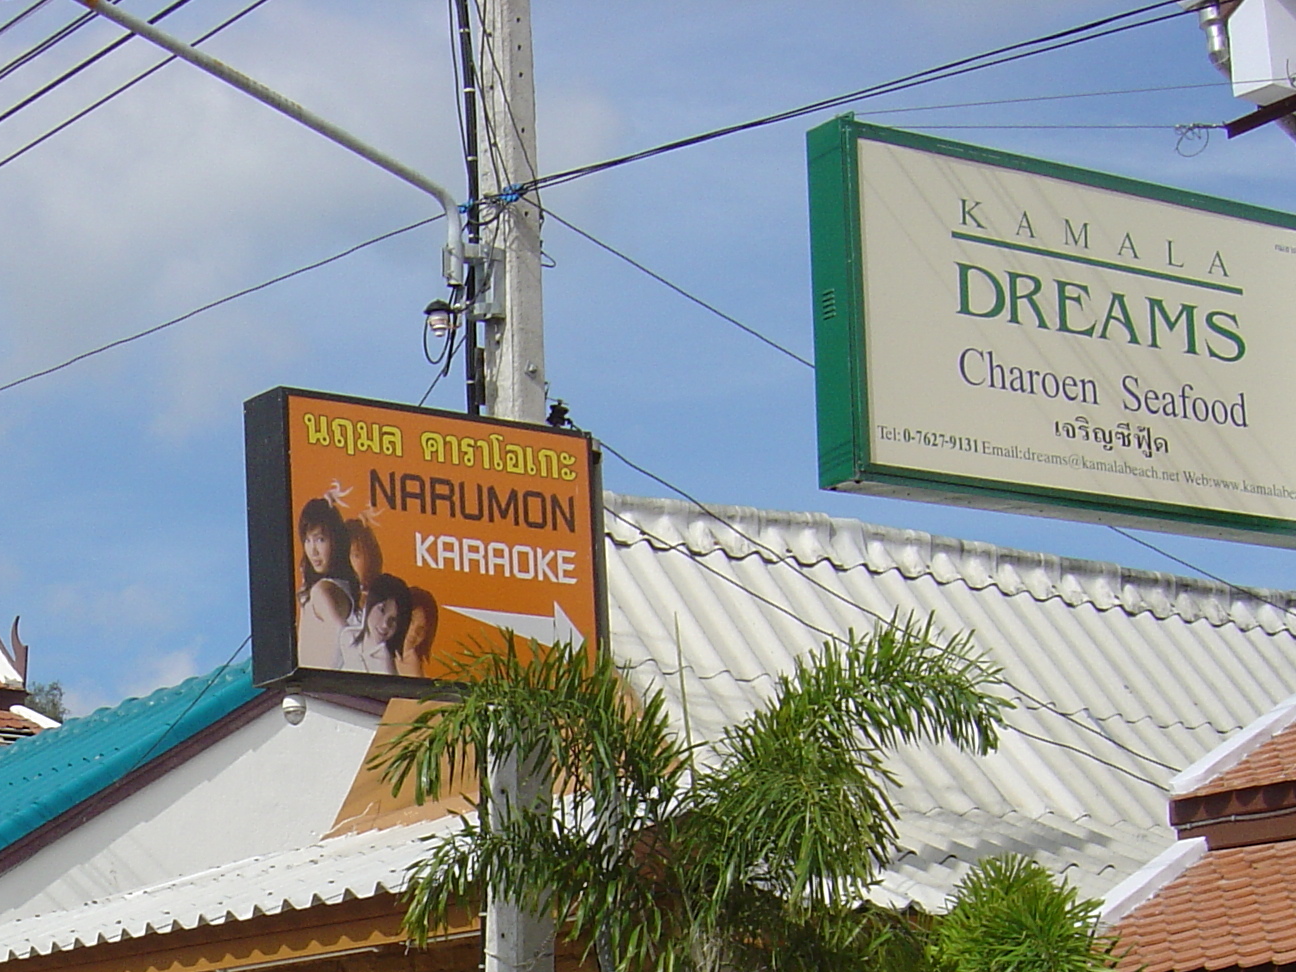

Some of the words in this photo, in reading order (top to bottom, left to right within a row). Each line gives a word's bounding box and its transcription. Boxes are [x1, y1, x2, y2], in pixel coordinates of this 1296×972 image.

[959, 198, 1230, 278] KAMALA
[953, 260, 1247, 363] DREAMS
[958, 346, 1100, 406] Charoen
[1121, 374, 1250, 429] Seafood
[419, 431, 578, 482] คาราโอเกะ
[877, 424, 901, 442] Tel:
[903, 427, 979, 454] 0-7627-9131
[369, 467, 577, 534] NARUMON
[414, 531, 579, 585] KARAOKE
